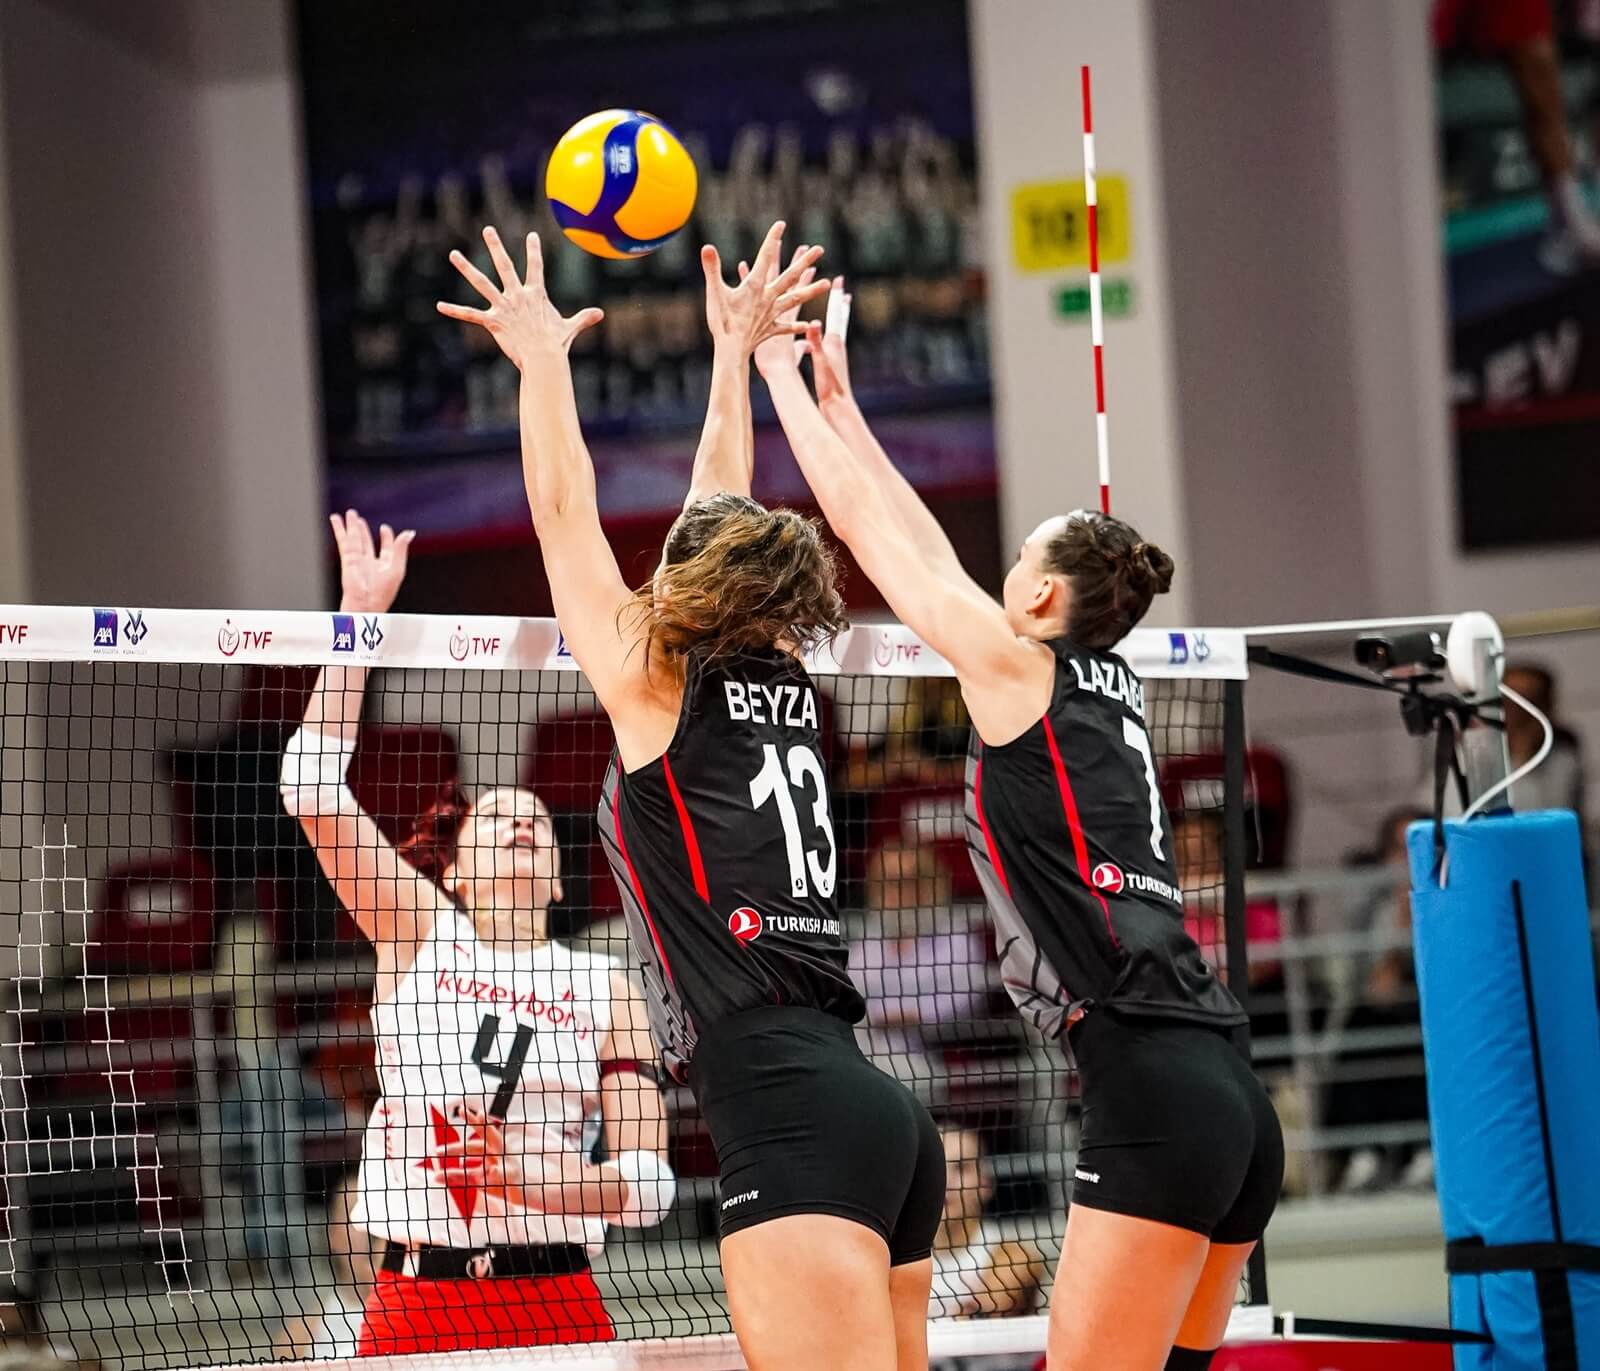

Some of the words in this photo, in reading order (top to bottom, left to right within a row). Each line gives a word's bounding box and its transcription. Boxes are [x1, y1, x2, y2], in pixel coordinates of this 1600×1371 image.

[243, 631, 272, 650] TVF
[472, 637, 500, 656] TVF
[896, 645, 921, 663] TVF
[724, 681, 818, 729] BEYZA
[1122, 716, 1166, 862] 7
[749, 743, 837, 898] 13
[766, 916, 820, 934] TURKISH
[471, 1013, 535, 1119] 4
